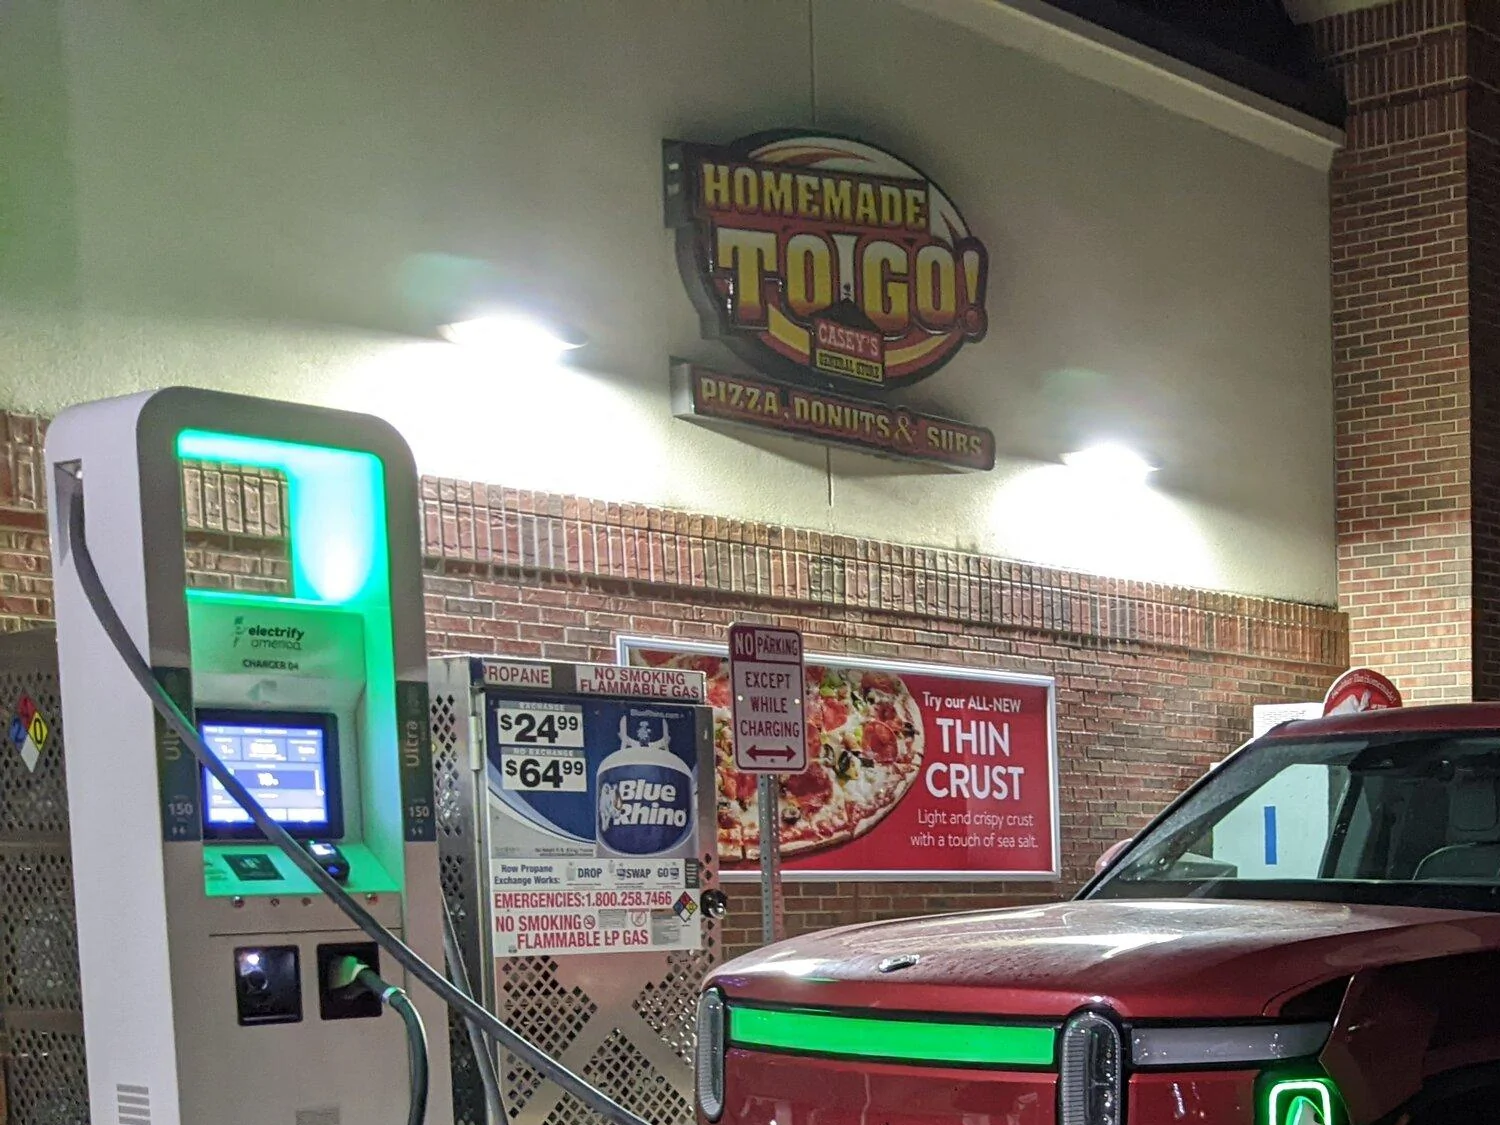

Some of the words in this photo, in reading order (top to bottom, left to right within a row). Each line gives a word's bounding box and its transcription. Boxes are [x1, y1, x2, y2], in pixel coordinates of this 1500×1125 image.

[702, 162, 927, 230] HOMEMADE
[716, 227, 833, 327] TO
[862, 242, 988, 332] GO!
[819, 323, 878, 356] CASEY'S
[793, 397, 889, 438] DONUTS
[893, 417, 916, 444] &
[927, 427, 982, 455] SUBS
[248, 625, 304, 641] electrify
[251, 638, 302, 651] america
[735, 632, 754, 656] NO
[757, 636, 798, 657] PARKING
[242, 659, 286, 670] CHARGER
[484, 665, 550, 685] ROPANE
[594, 667, 615, 680] NO
[620, 669, 685, 685] SMOKING
[745, 671, 790, 689] EXCEPT
[580, 679, 667, 696] FLAMMABLE
[671, 685, 699, 699] GAS
[750, 696, 788, 713] WHILE
[922, 691, 941, 712] Try
[945, 698, 965, 709] our
[968, 696, 1022, 713] ALL-NEW
[34, 717, 42, 745] 0
[740, 720, 800, 738] CHARGING
[936, 718, 1010, 757] THIN
[406, 719, 420, 767] Ultra
[528, 748, 574, 757] EXCHANGE
[925, 762, 1024, 800] CRUST
[619, 779, 676, 802] Blue
[168, 802, 194, 816] 150
[409, 805, 431, 818] 150
[613, 802, 687, 827] Rhino
[918, 809, 947, 828] Light
[950, 811, 971, 825] and
[974, 811, 1004, 830] crispy
[1007, 814, 1034, 827] crust
[911, 831, 935, 847] with
[938, 835, 945, 847] a
[948, 832, 981, 847] touch
[984, 832, 995, 847] of
[998, 836, 1016, 848] sea
[1018, 834, 1038, 848] salt.
[521, 864, 553, 874] Propane
[577, 867, 603, 878] DROP
[626, 868, 651, 879] SWAP
[657, 867, 669, 878] GO
[494, 876, 532, 886] Exchange
[534, 876, 560, 885] Works:
[496, 915, 514, 932] NO
[518, 915, 582, 932] SMOKING
[517, 931, 600, 950] FLAMMABLE
[604, 931, 620, 945] LP
[623, 930, 648, 946] GAS
